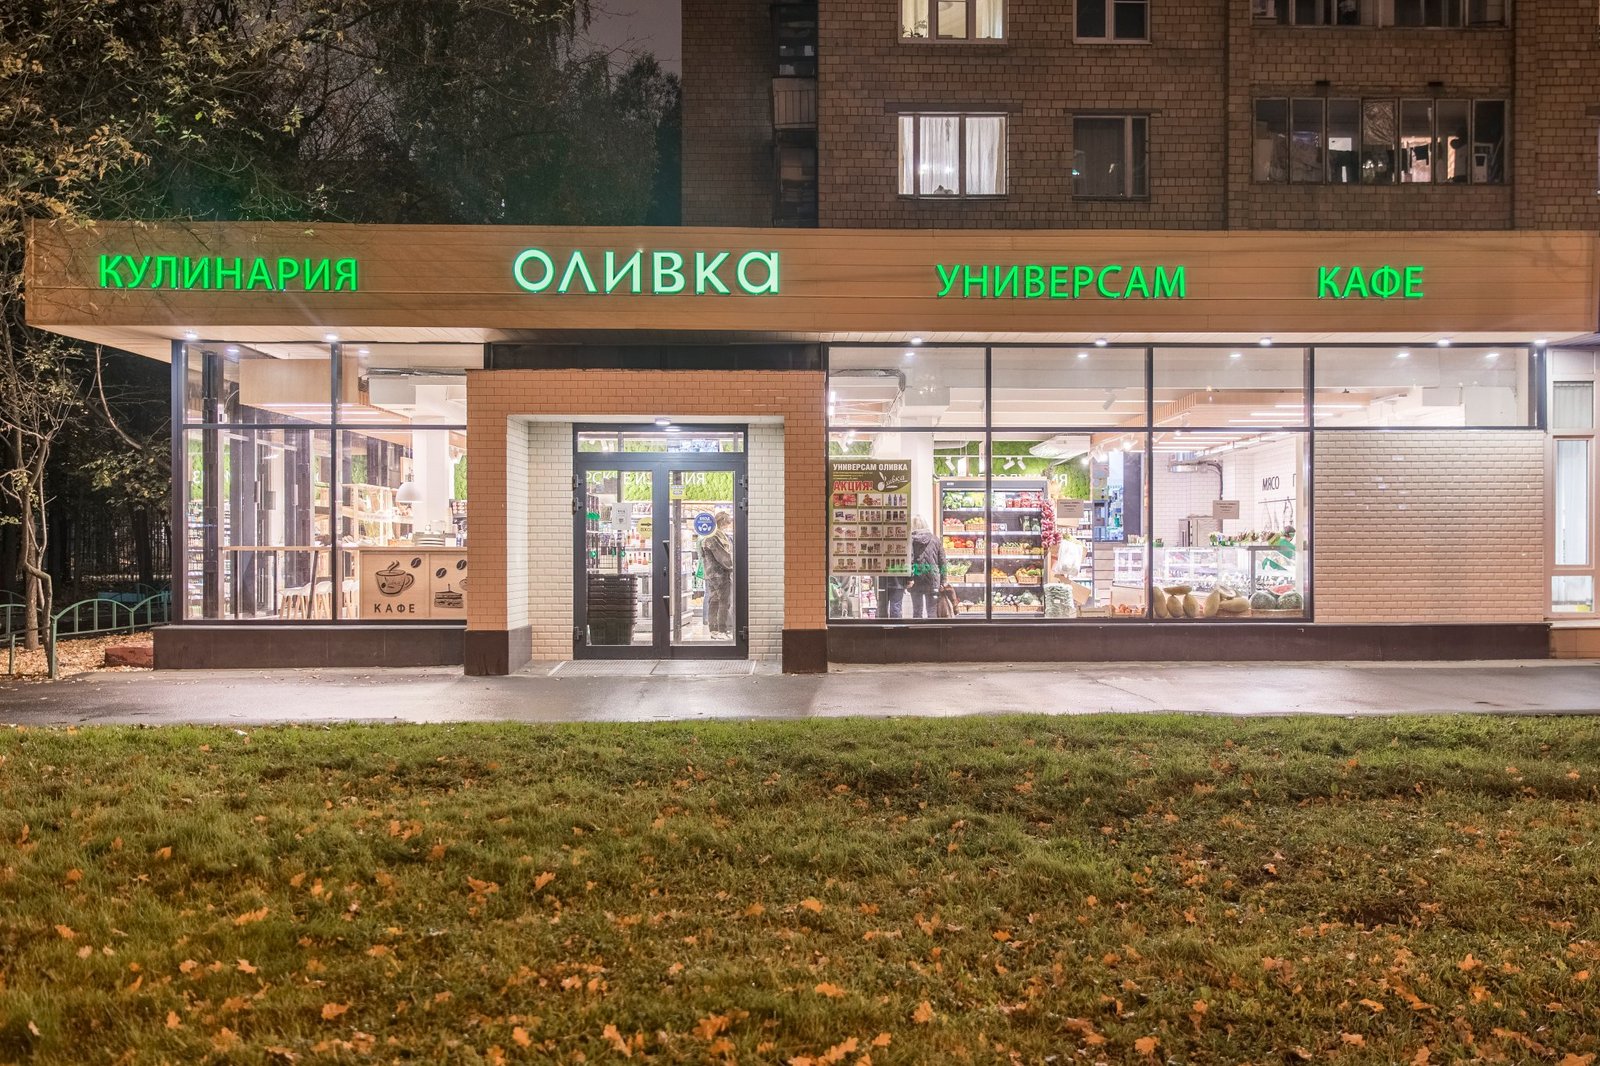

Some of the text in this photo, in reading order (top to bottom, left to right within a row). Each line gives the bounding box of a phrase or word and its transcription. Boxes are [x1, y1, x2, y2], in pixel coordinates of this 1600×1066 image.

[99, 254, 356, 290] КУЛИНАРИЯ
[938, 264, 1186, 298] УНИВЕРСАМ
[1320, 265, 1424, 298] КАФЕ
[833, 481, 873, 491] АКЦИЯ!
[1262, 475, 1280, 491] МЯСО
[374, 603, 415, 613] КАФЕ
